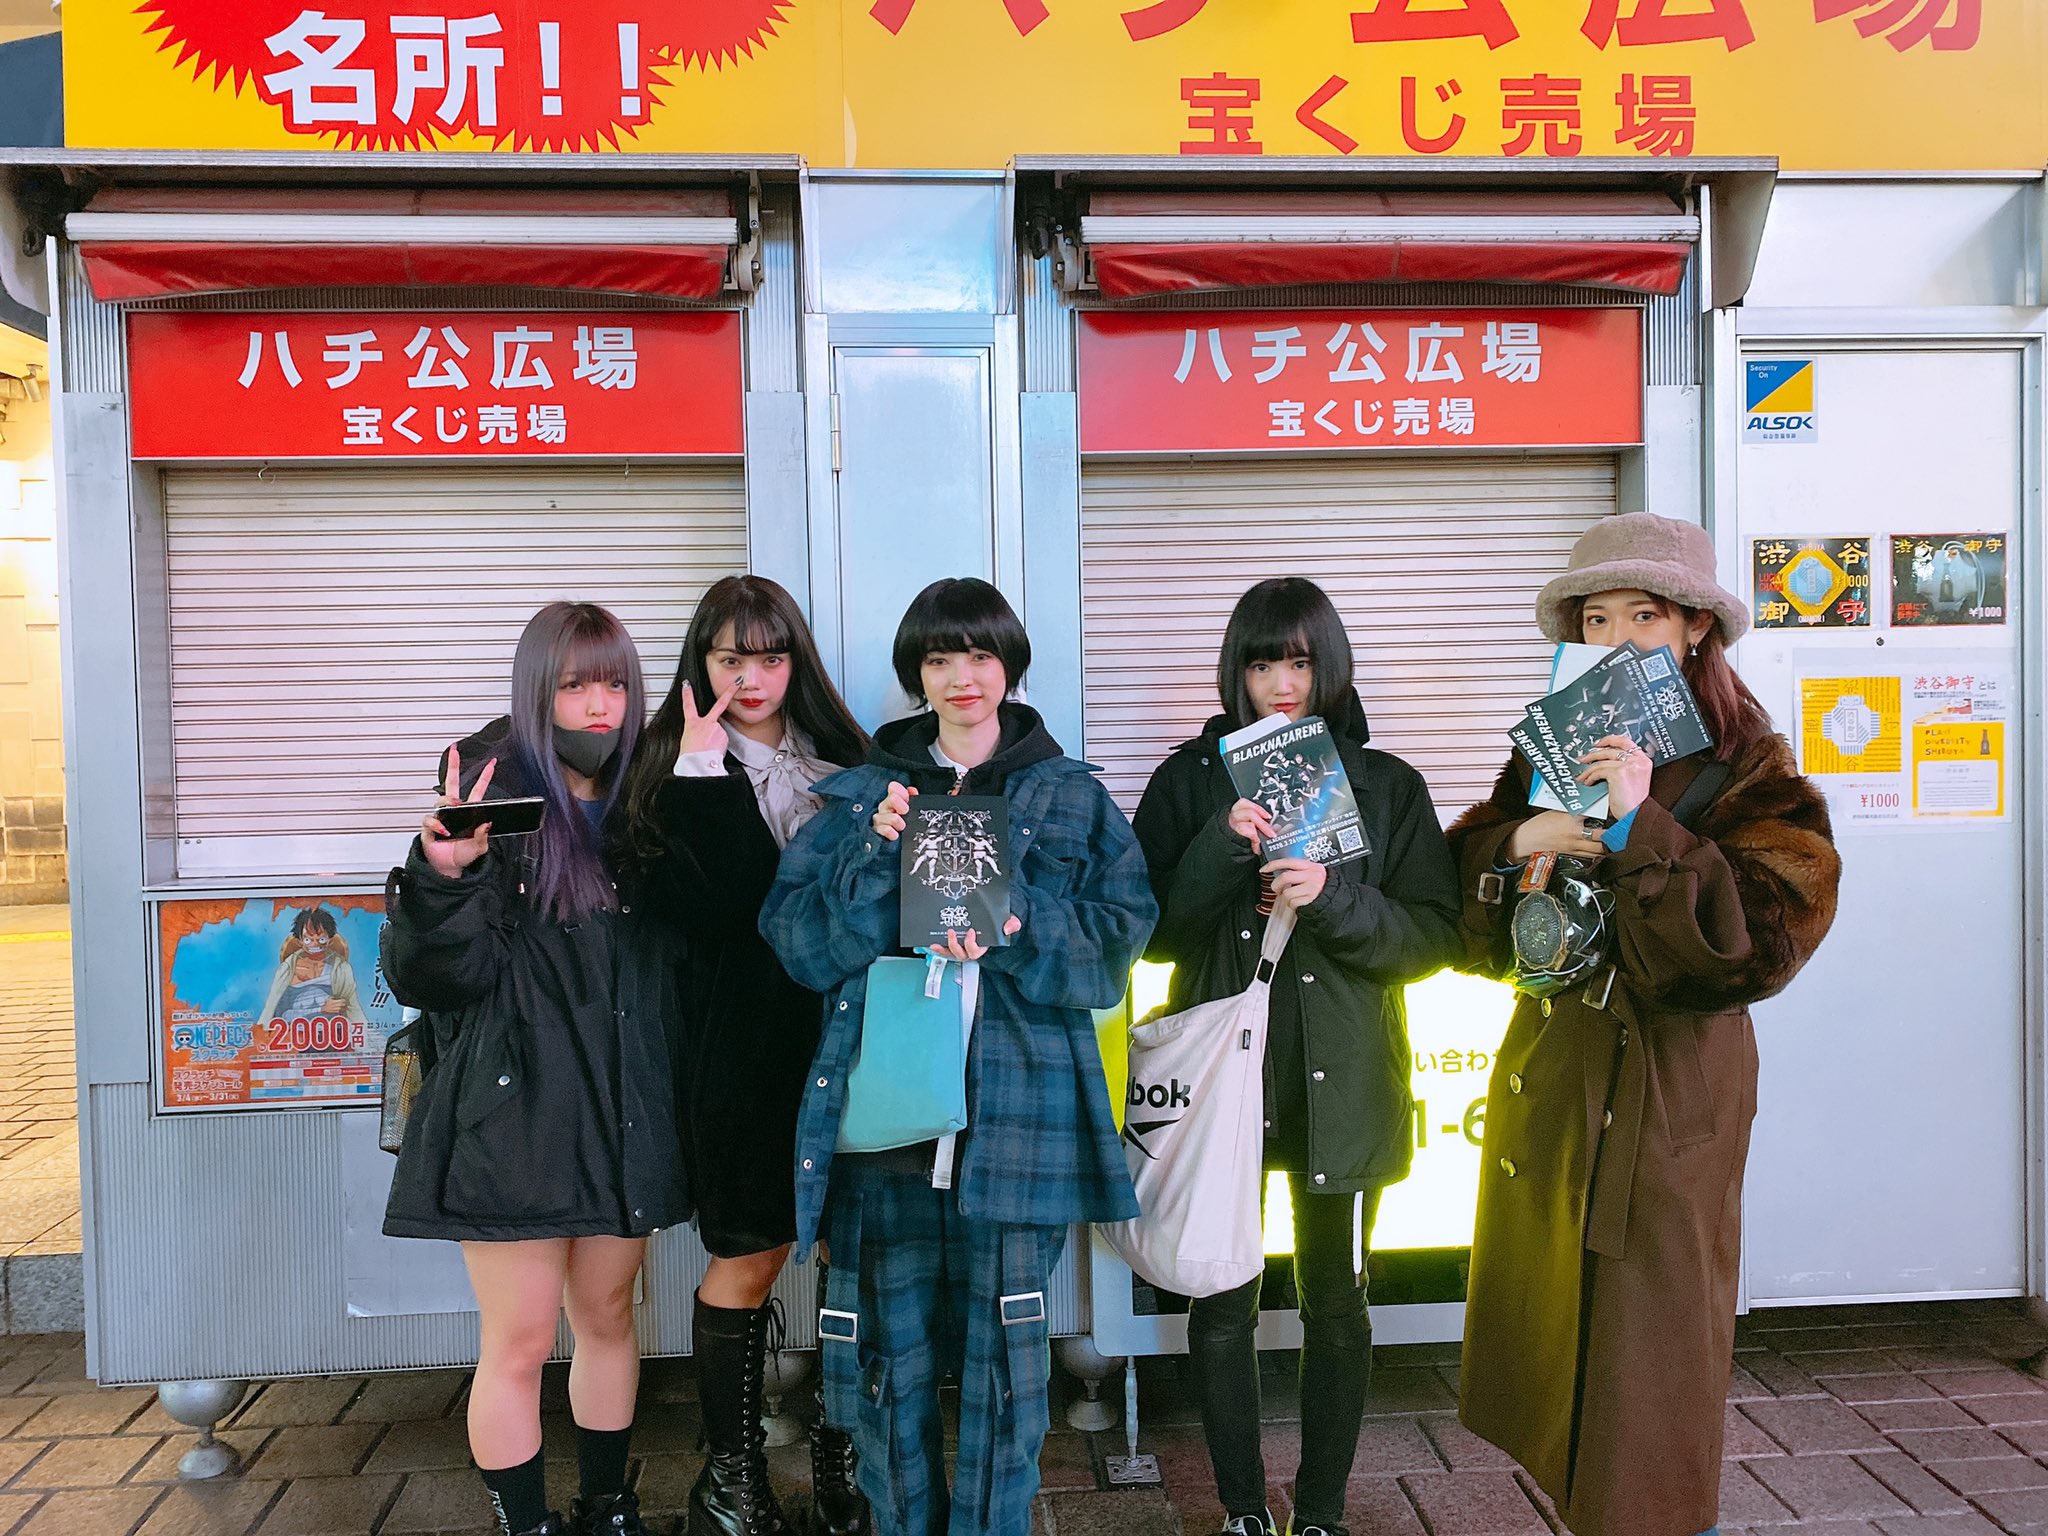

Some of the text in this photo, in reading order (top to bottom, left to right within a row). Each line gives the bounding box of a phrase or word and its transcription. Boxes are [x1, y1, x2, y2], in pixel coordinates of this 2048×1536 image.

[1180, 73, 1697, 156] 宝くじ売場
[238, 326, 638, 391] ハチ公広場
[1174, 321, 1543, 384] ハチ公広場
[342, 404, 567, 446] 宝くじ売場
[1268, 397, 1475, 437] 宝くじ売場
[1747, 416, 1813, 429] ALSOK
[1232, 722, 1324, 764] BLACKNAZARENE
[1529, 704, 1581, 797] BLACKNAZARENE
[1861, 794, 1899, 807] ¥1000
[1126, 1076, 1191, 1108] bok
